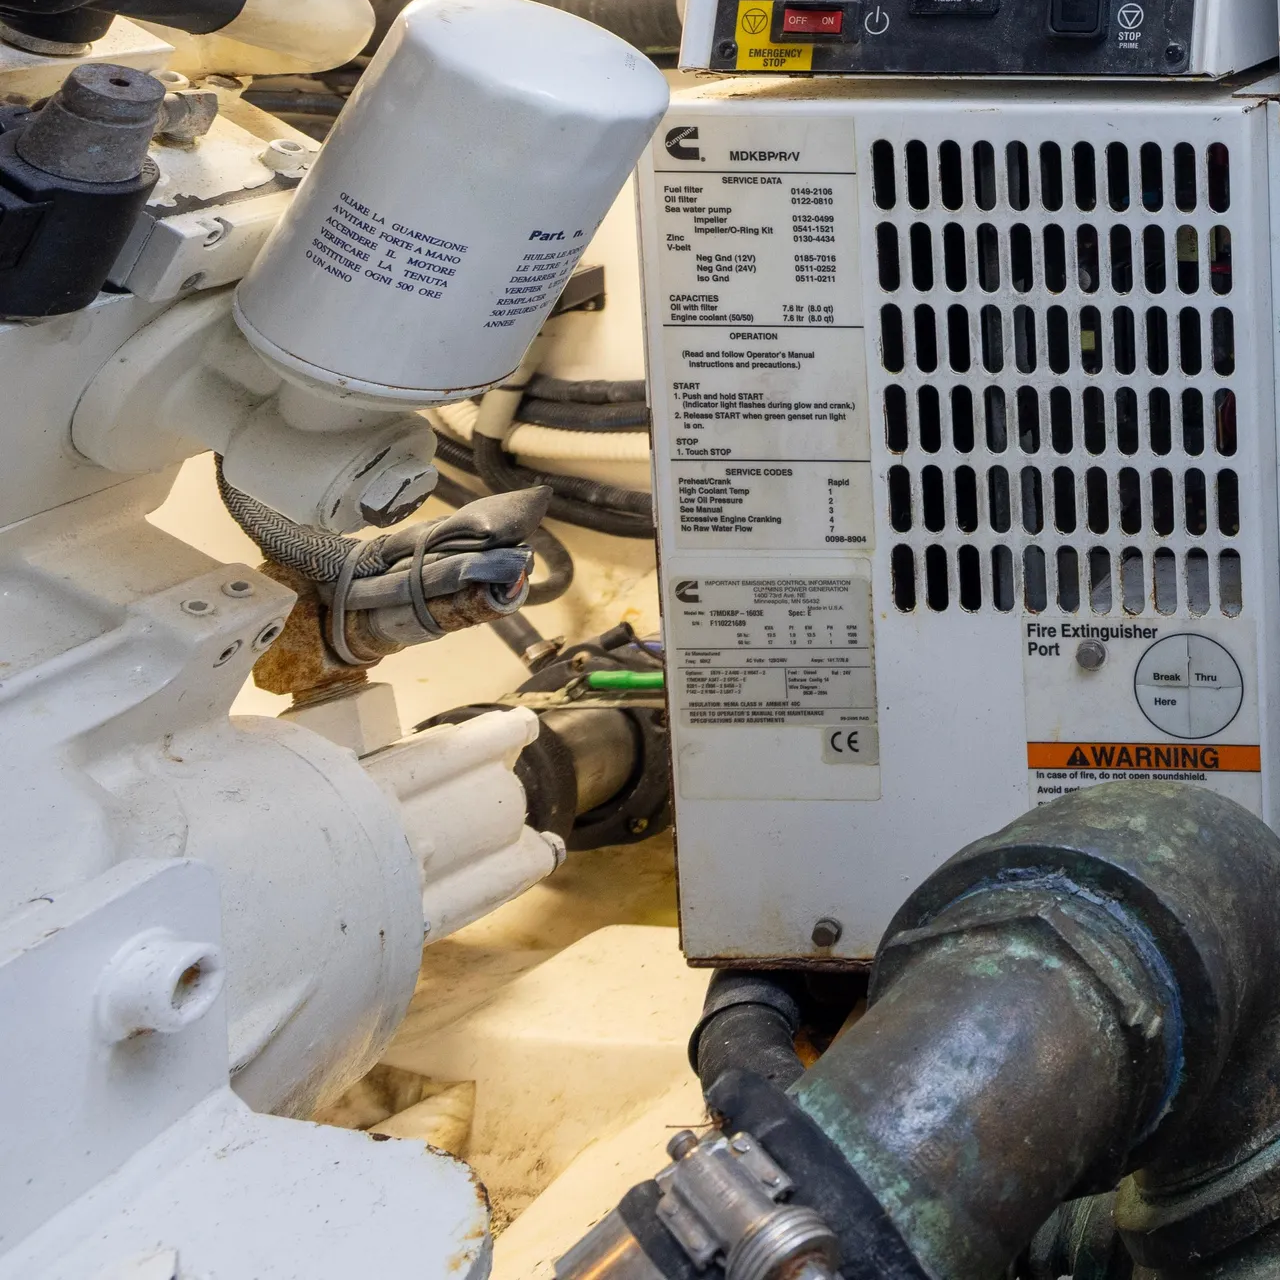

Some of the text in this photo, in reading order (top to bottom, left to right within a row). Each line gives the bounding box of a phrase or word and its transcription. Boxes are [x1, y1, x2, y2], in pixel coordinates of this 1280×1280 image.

[788, 16, 807, 24] OFF
[1118, 32, 1141, 40] STOP
[750, 49, 802, 57] EMERGENCY
[763, 58, 786, 67] STOP
[730, 151, 800, 161] MDKBP/R/V
[340, 192, 468, 253] OLIARE LA GUARNIZIONE
[333, 204, 461, 264] AVVITARE FORTE A MANO
[528, 230, 566, 241] Part.
[523, 253, 556, 261] HUILER
[1027, 624, 1158, 639] Fire Extinguisher
[1028, 642, 1060, 656] Port
[1154, 673, 1180, 681] Break
[1195, 673, 1216, 681] Thru
[1091, 746, 1219, 769] WARNING
[1069, 771, 1078, 779] of
[1080, 771, 1096, 780] fire,
